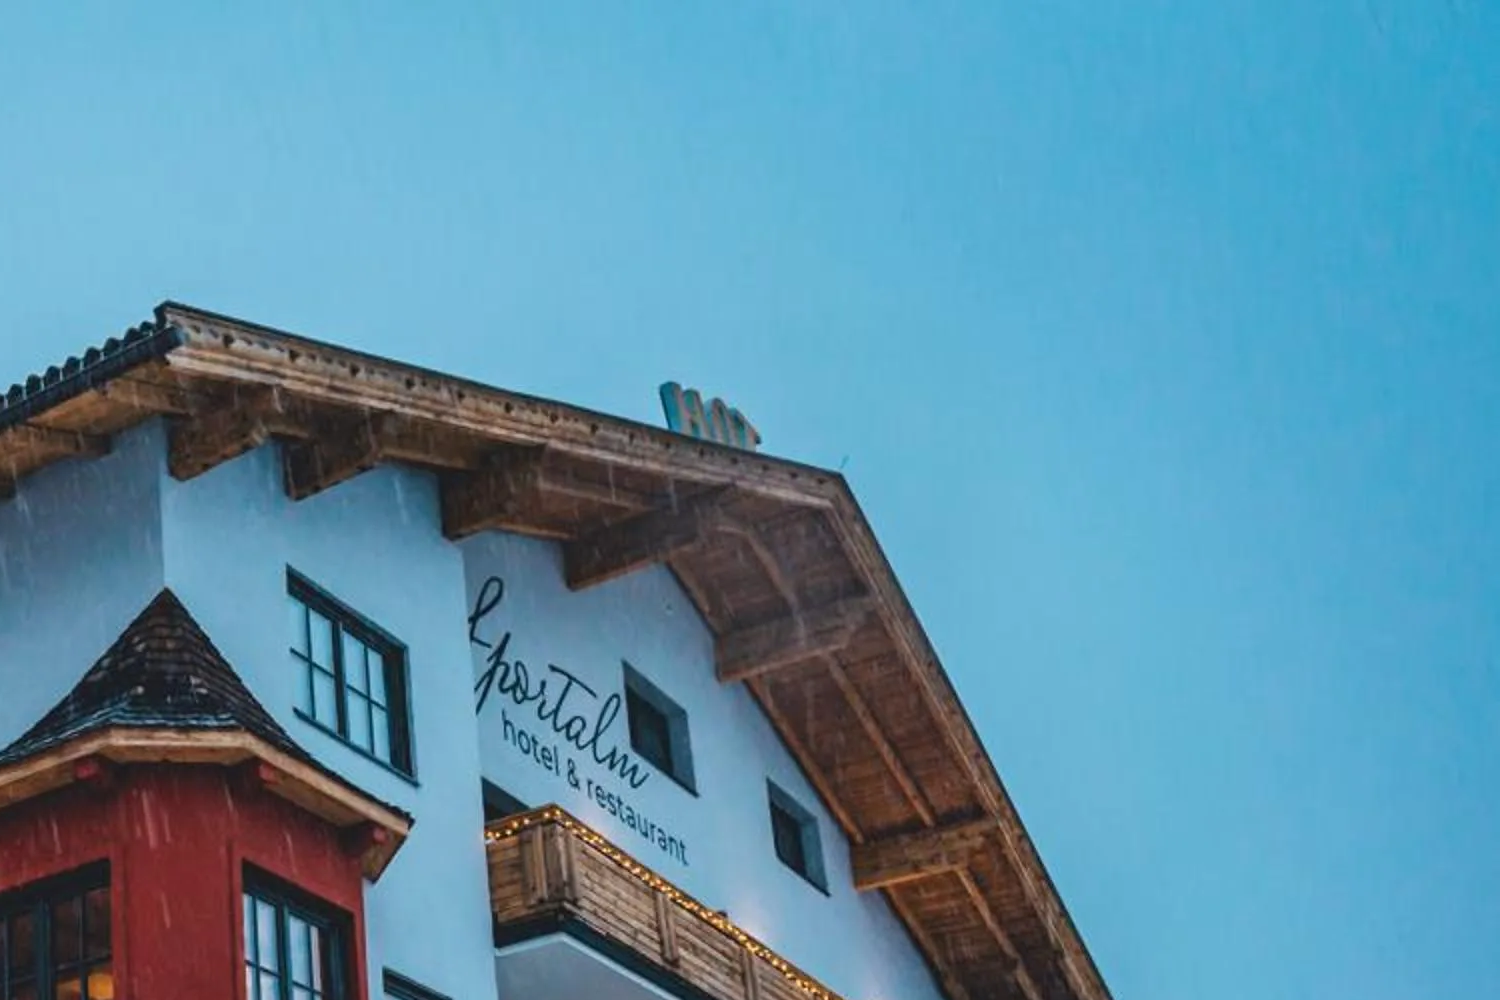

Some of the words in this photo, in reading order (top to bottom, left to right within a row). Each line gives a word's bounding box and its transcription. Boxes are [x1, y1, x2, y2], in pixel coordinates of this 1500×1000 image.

[467, 575, 651, 789] Sportalm
[501, 708, 560, 777] hotel
[566, 757, 581, 791] &
[587, 778, 690, 867] restaurant
